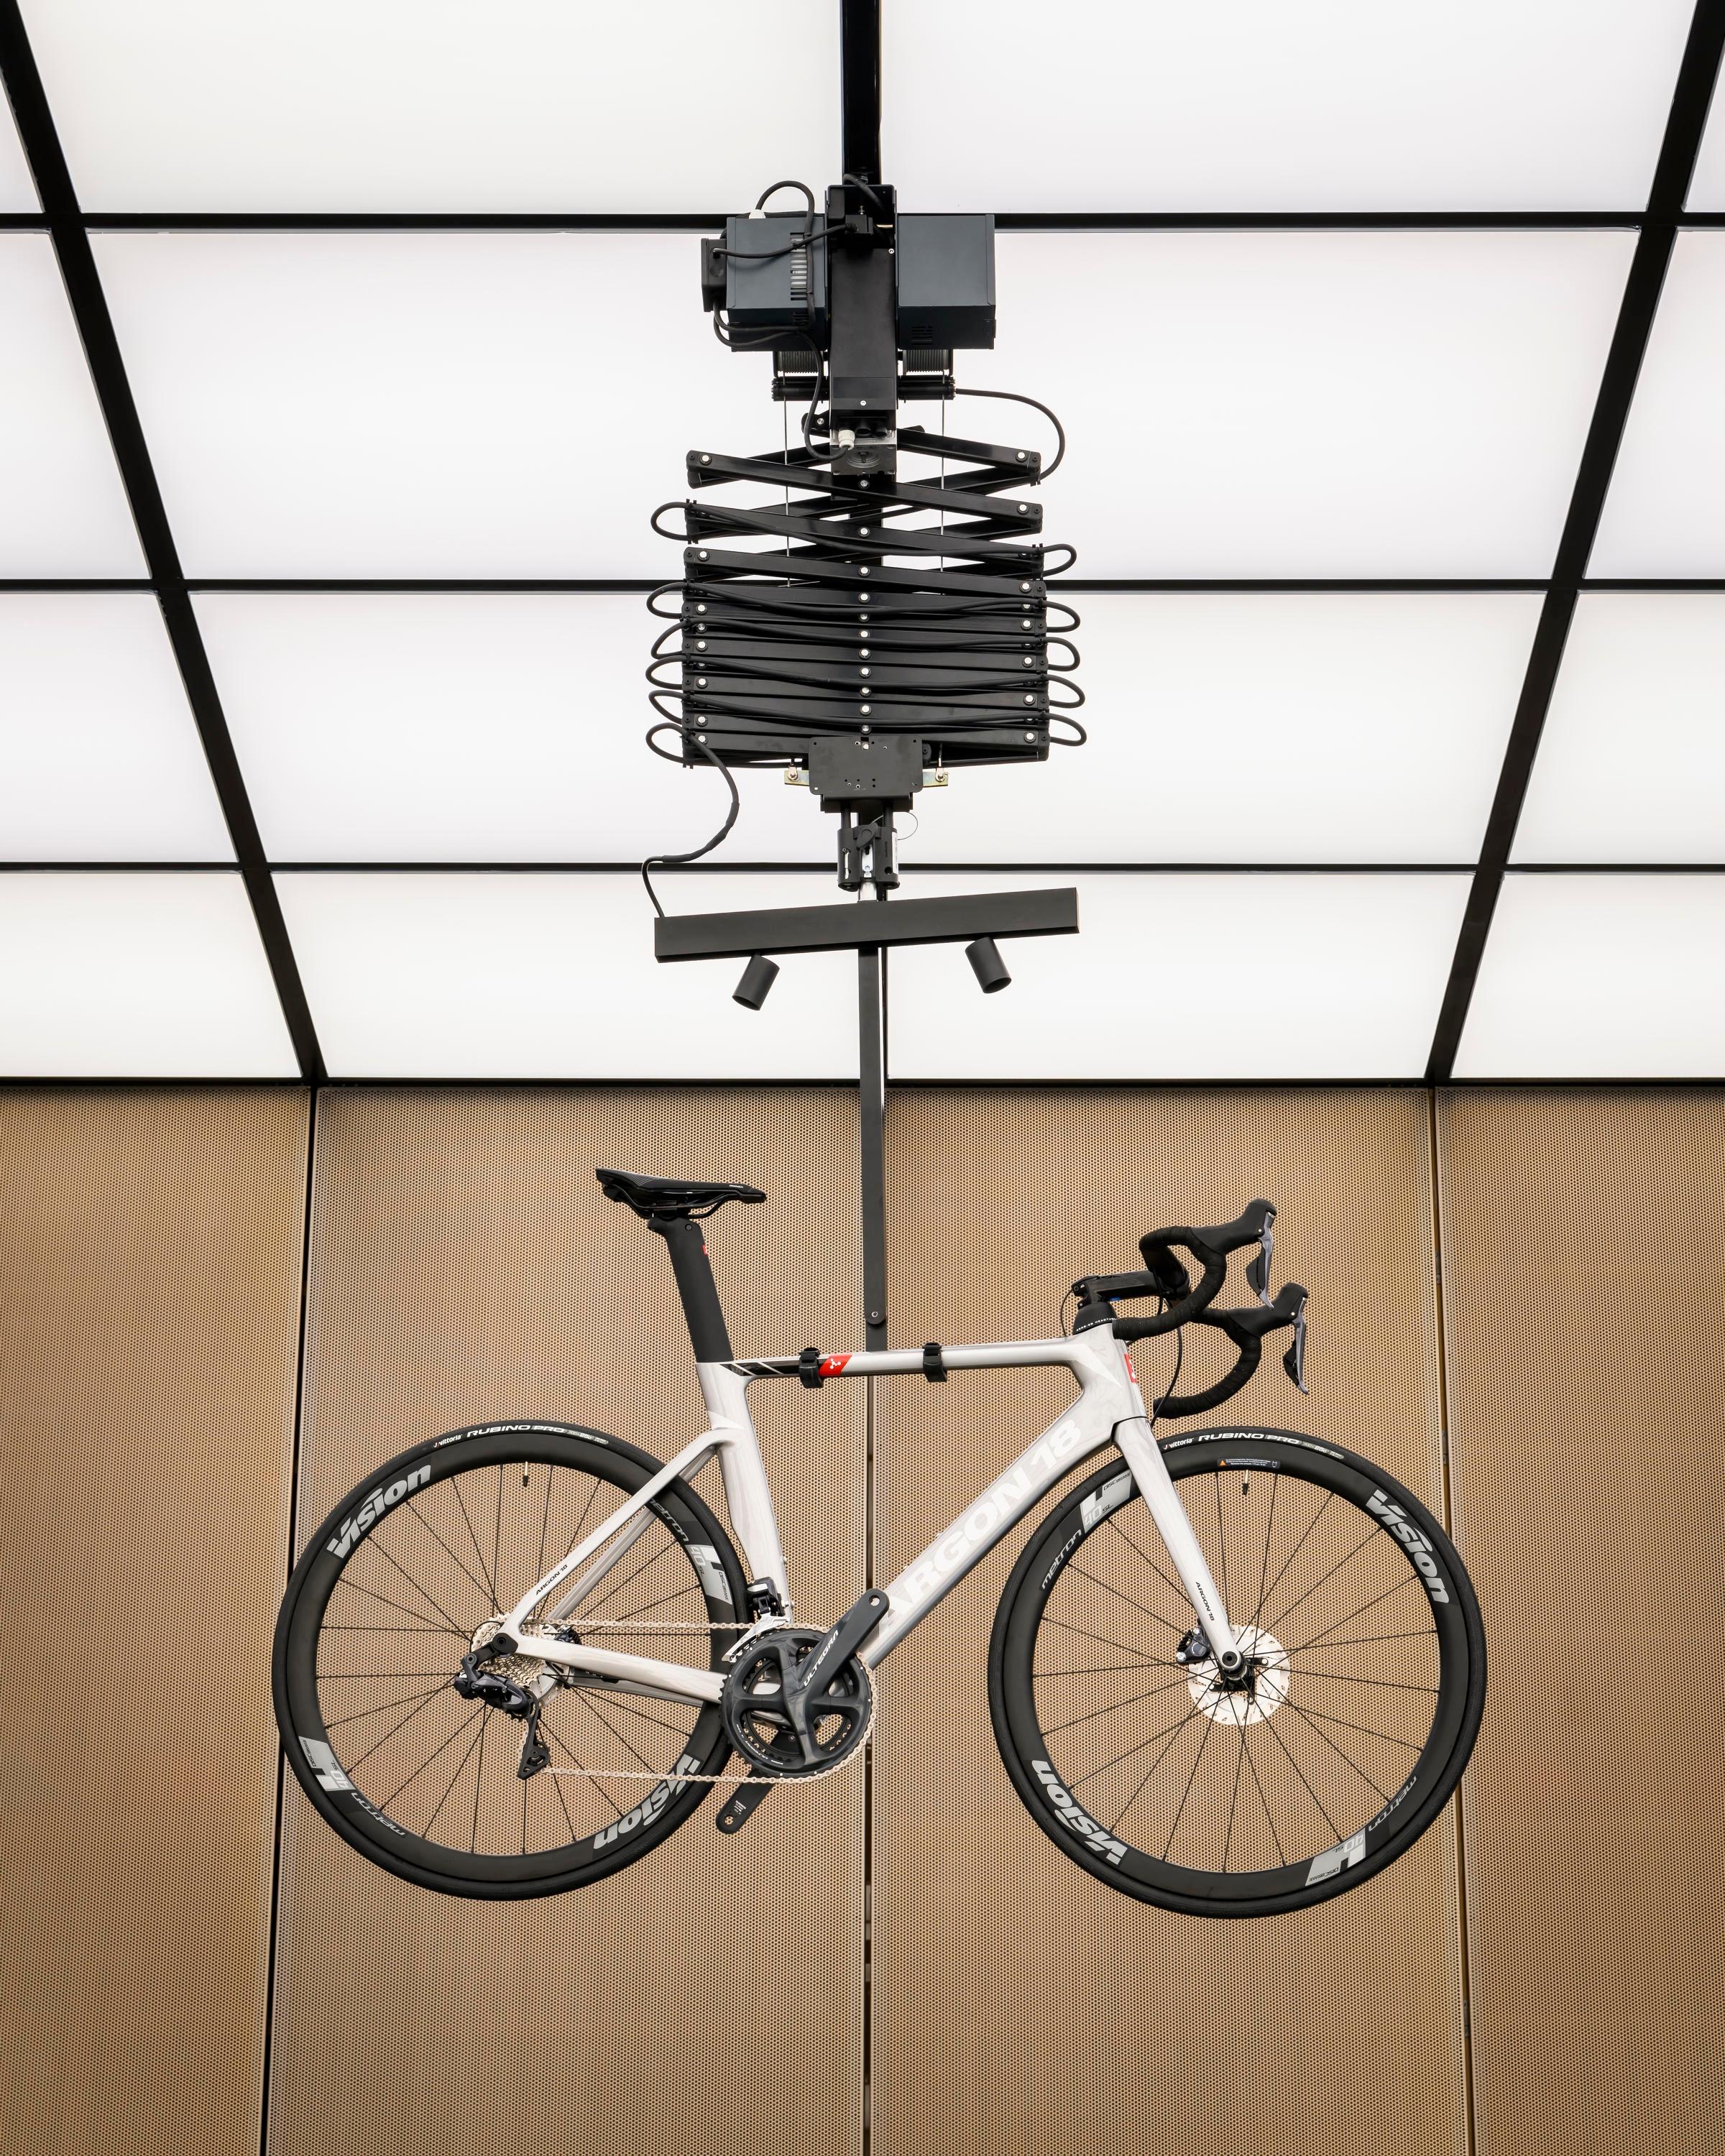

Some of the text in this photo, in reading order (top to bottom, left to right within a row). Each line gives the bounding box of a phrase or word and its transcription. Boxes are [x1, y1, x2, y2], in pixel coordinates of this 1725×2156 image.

[467, 1425, 530, 1437] RUBINO
[1199, 1432, 1264, 1442] RUBINO
[1266, 1434, 1300, 1445] PRO
[326, 1465, 431, 1559] Vision
[879, 1419, 1081, 1627] ARGON 18
[1085, 1504, 1113, 1525] 40 SL
[1041, 1529, 1082, 1590] metron
[1365, 1489, 1450, 1603] Vision
[536, 1571, 560, 1595] ARGON
[1195, 1581, 1215, 1621] ARGON 18
[804, 1629, 839, 1687] ULTEGRA
[351, 1792, 405, 1836] metron
[592, 1754, 701, 1851] Vision
[1031, 1759, 1128, 1866] Vision
[1368, 1776, 1417, 1832] metron
[1343, 1833, 1363, 1853] 40
